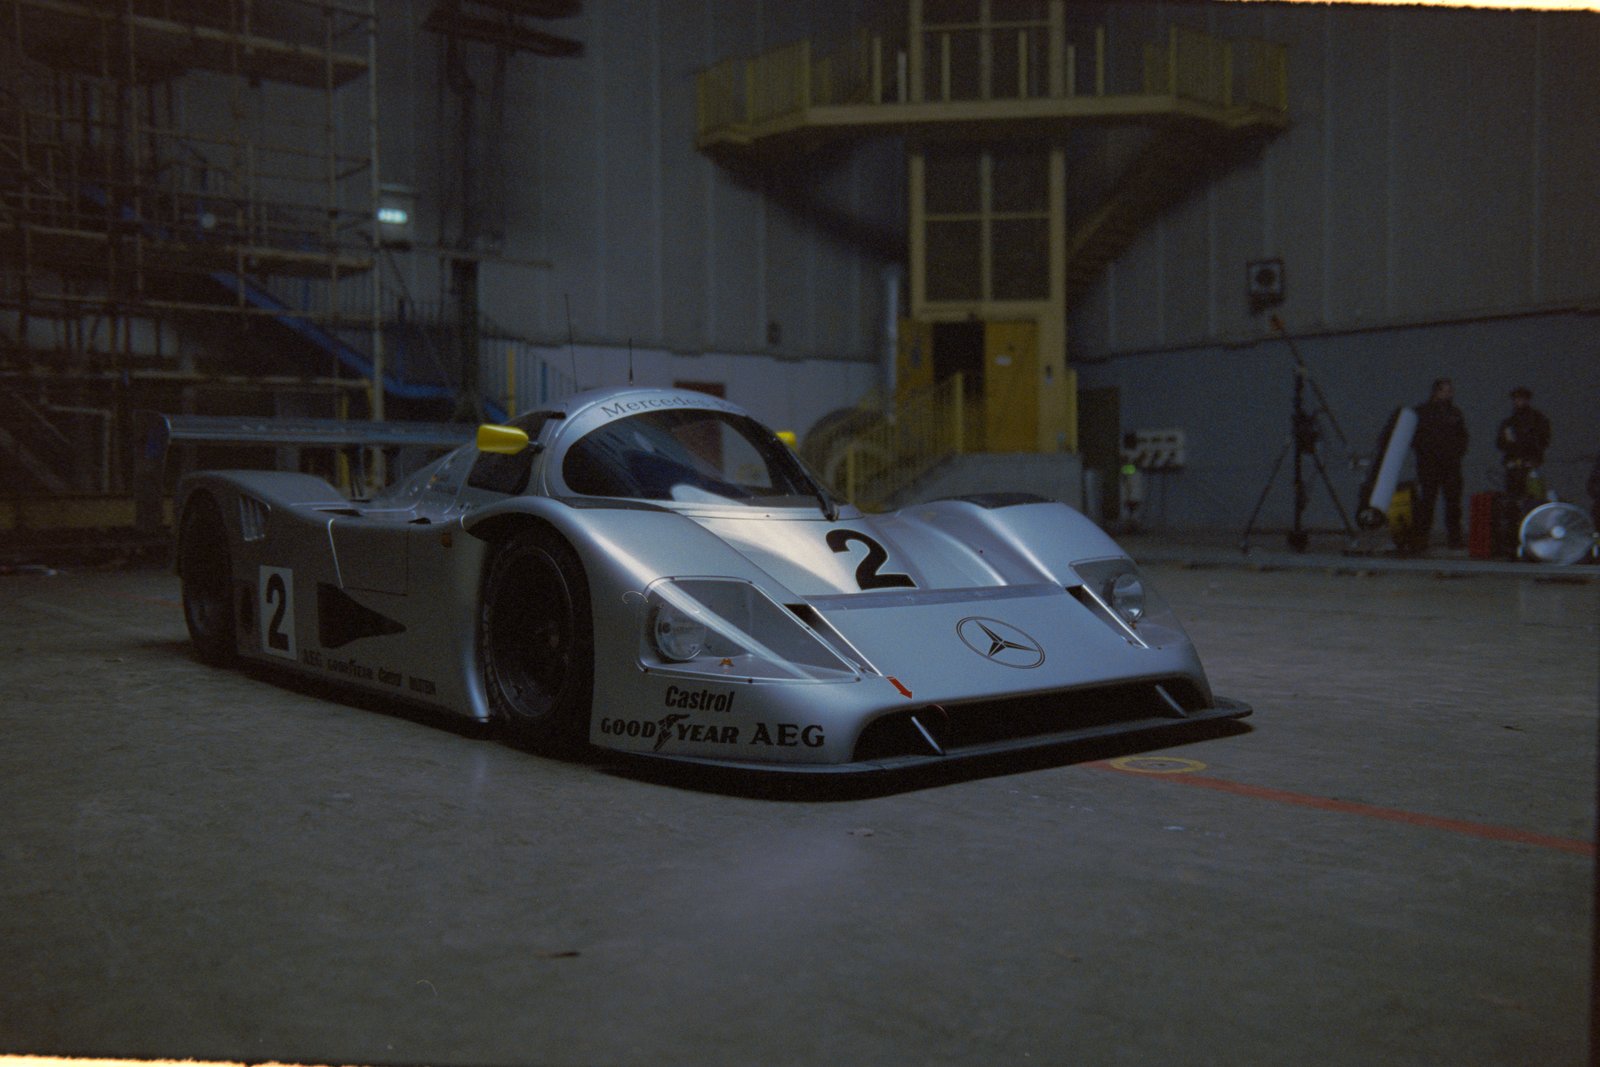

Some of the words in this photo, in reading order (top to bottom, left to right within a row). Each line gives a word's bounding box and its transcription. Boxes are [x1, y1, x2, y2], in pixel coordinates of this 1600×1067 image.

[826, 529, 917, 591] 2
[266, 573, 289, 652] 2
[665, 685, 735, 713] Castrol
[749, 722, 825, 748] AEG
